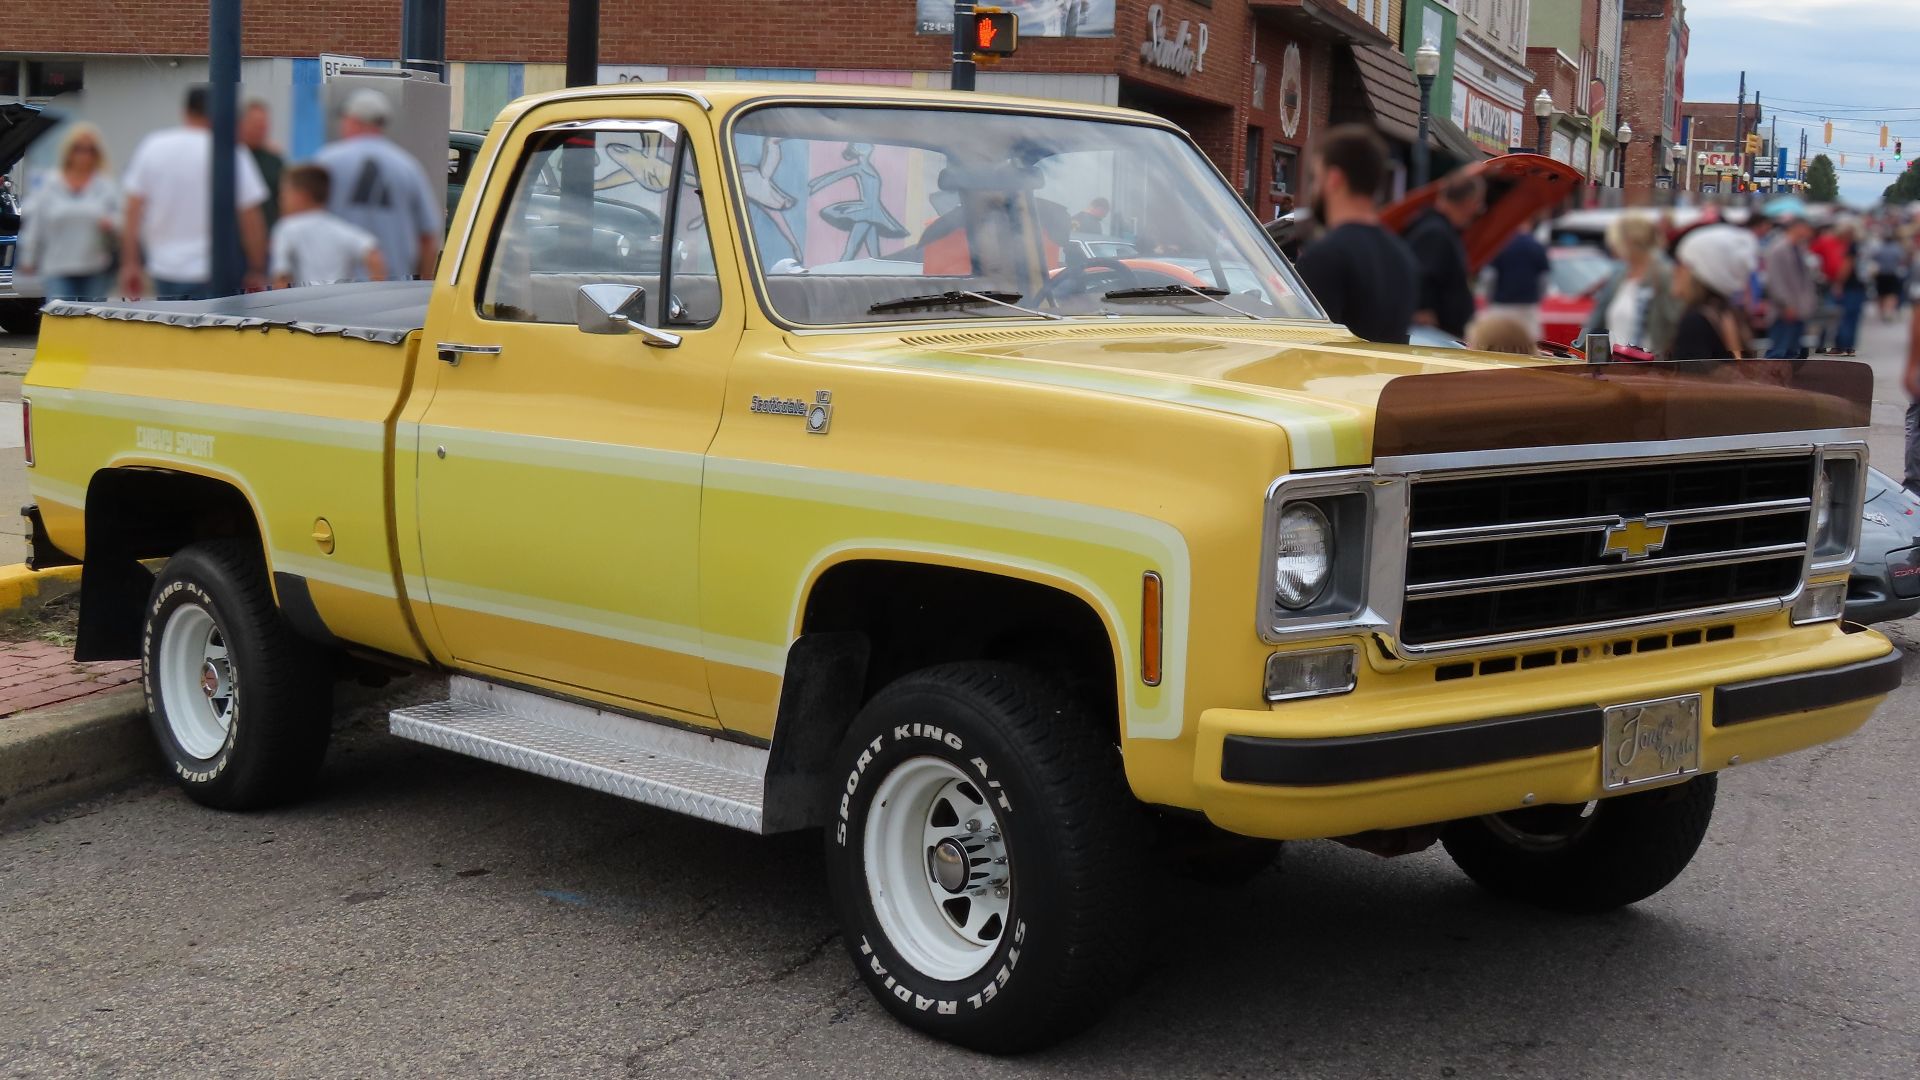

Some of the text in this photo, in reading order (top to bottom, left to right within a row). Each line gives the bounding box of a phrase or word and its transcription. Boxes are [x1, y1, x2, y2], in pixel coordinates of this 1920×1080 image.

[750, 395, 806, 416] Scottsdale
[176, 431, 216, 458] SPORT
[143, 581, 212, 714] SPORT KING A/T
[175, 755, 227, 782] RADIAL
[836, 723, 1013, 847] SPORT KING A/T
[860, 918, 1026, 1015] STEEL RADIAL
